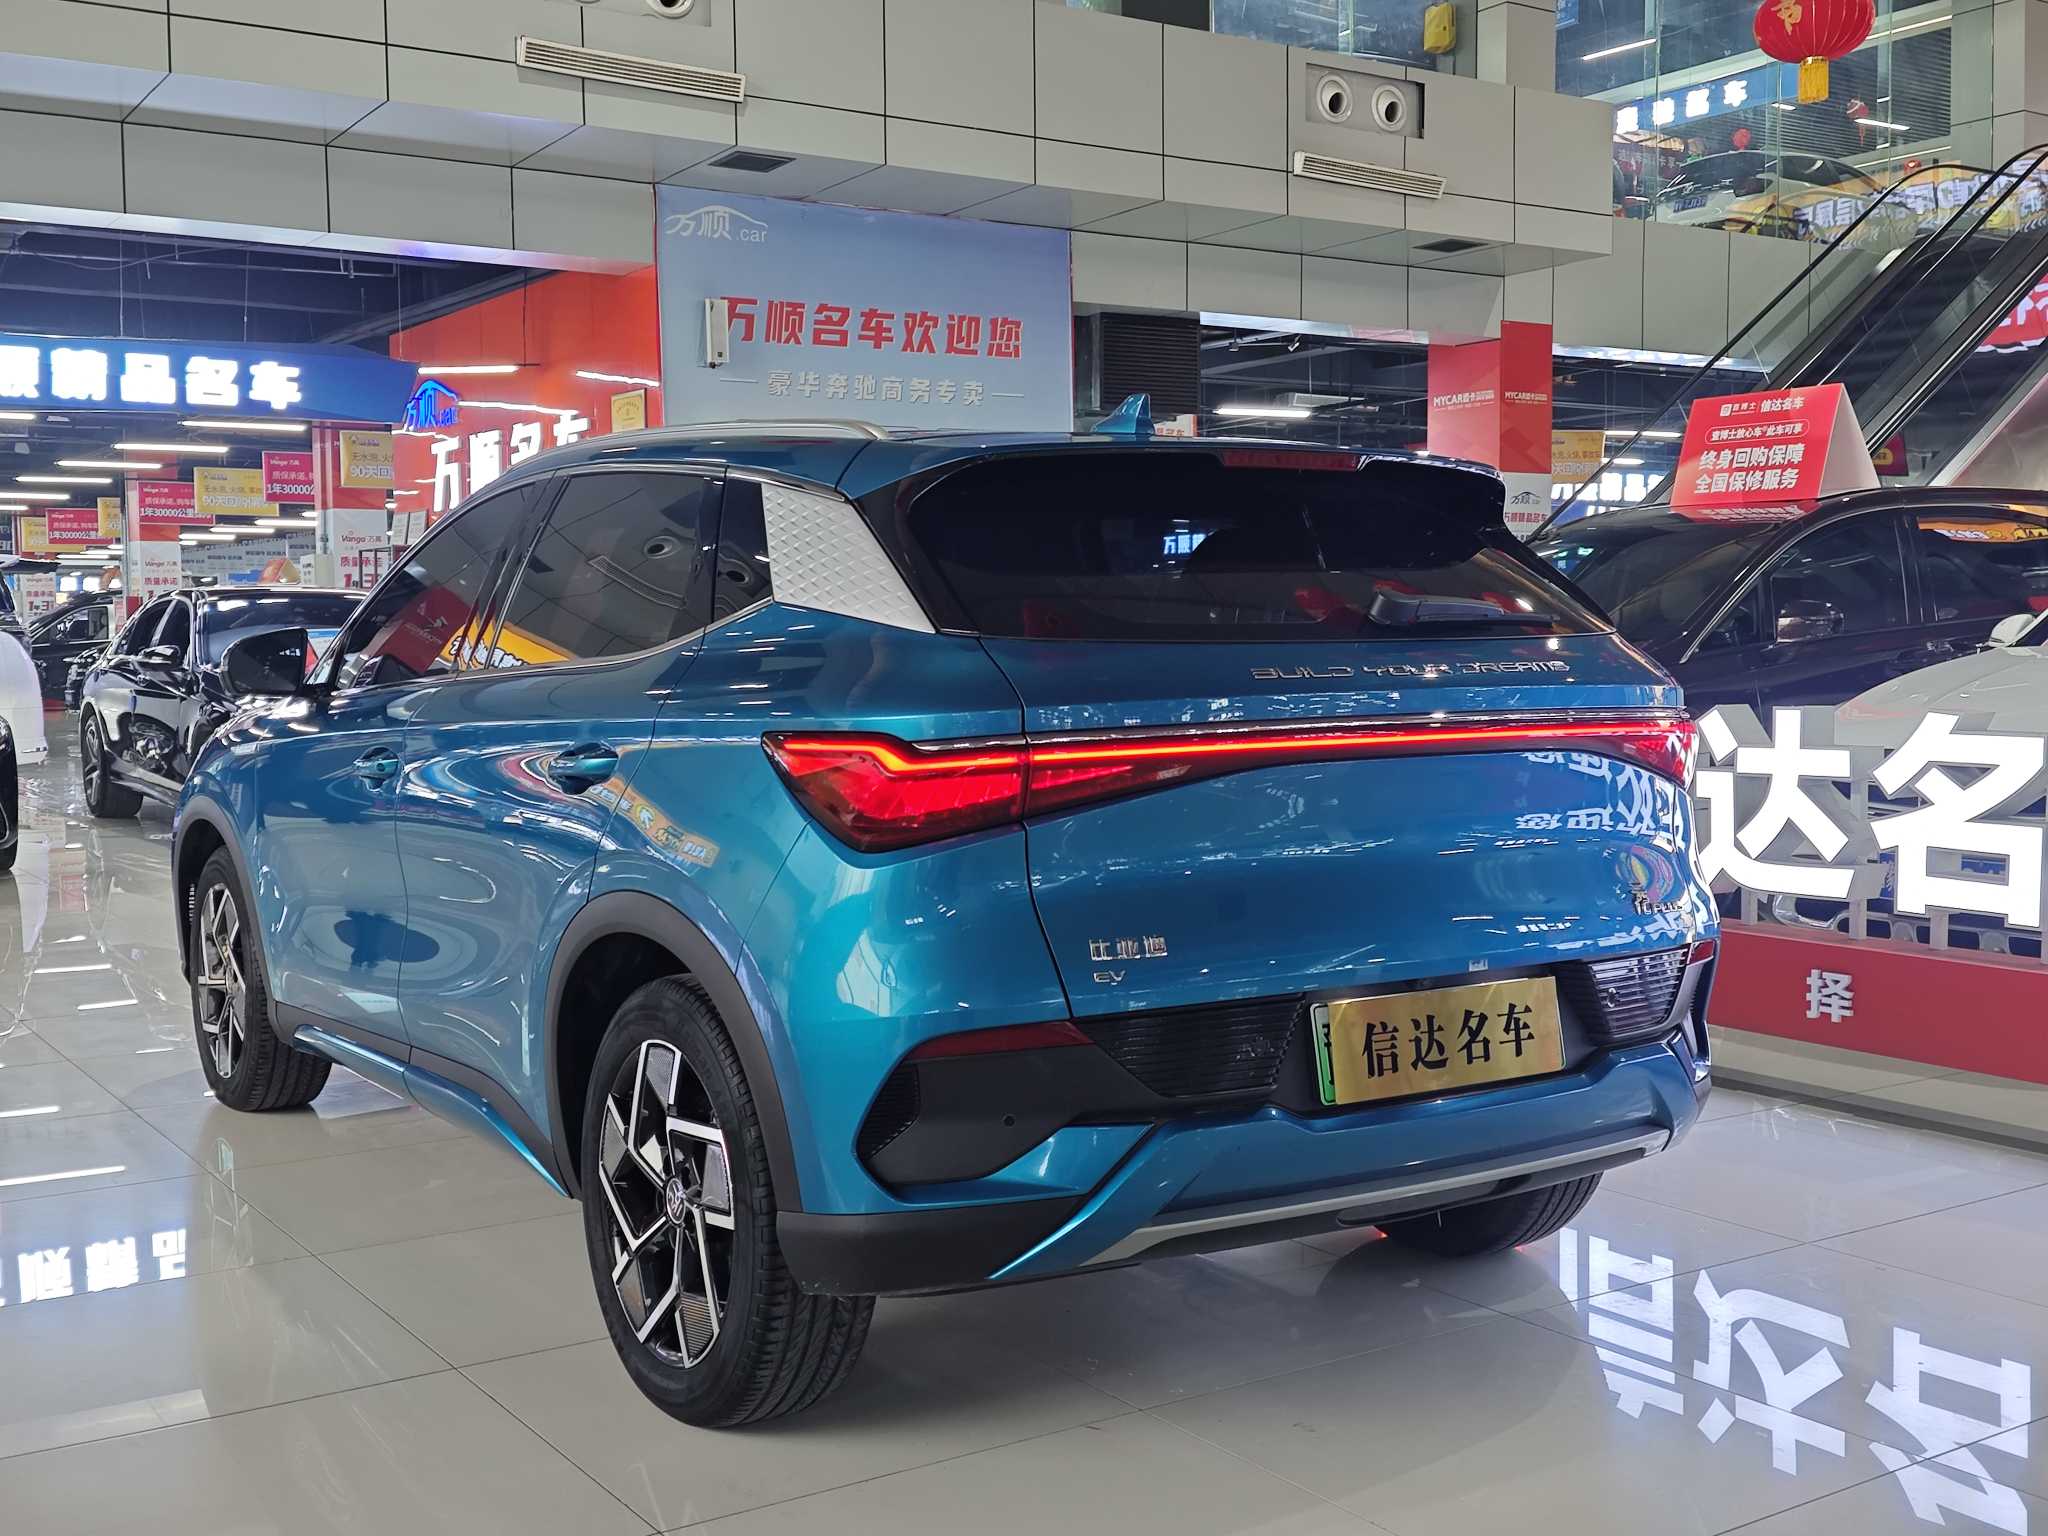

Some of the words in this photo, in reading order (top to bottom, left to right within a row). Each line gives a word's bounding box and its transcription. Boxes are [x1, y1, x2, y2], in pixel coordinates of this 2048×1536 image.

[719, 297, 1024, 361] 万顺名车欢迎您
[767, 371, 986, 407] 豪华奔驰商务专卖
[1699, 443, 1806, 471] 终身回购保障
[1694, 468, 1800, 494] 全国保修服务
[1251, 666, 1355, 679] BUILD
[1362, 664, 1452, 677] YOUR
[1457, 660, 1570, 673] DREAMS
[1694, 708, 2046, 928] 达名
[1088, 935, 1168, 960] 比亚迪
[1093, 970, 1126, 983] EV
[1806, 968, 1854, 1023] 择
[1361, 1003, 1535, 1079] 信达名车
